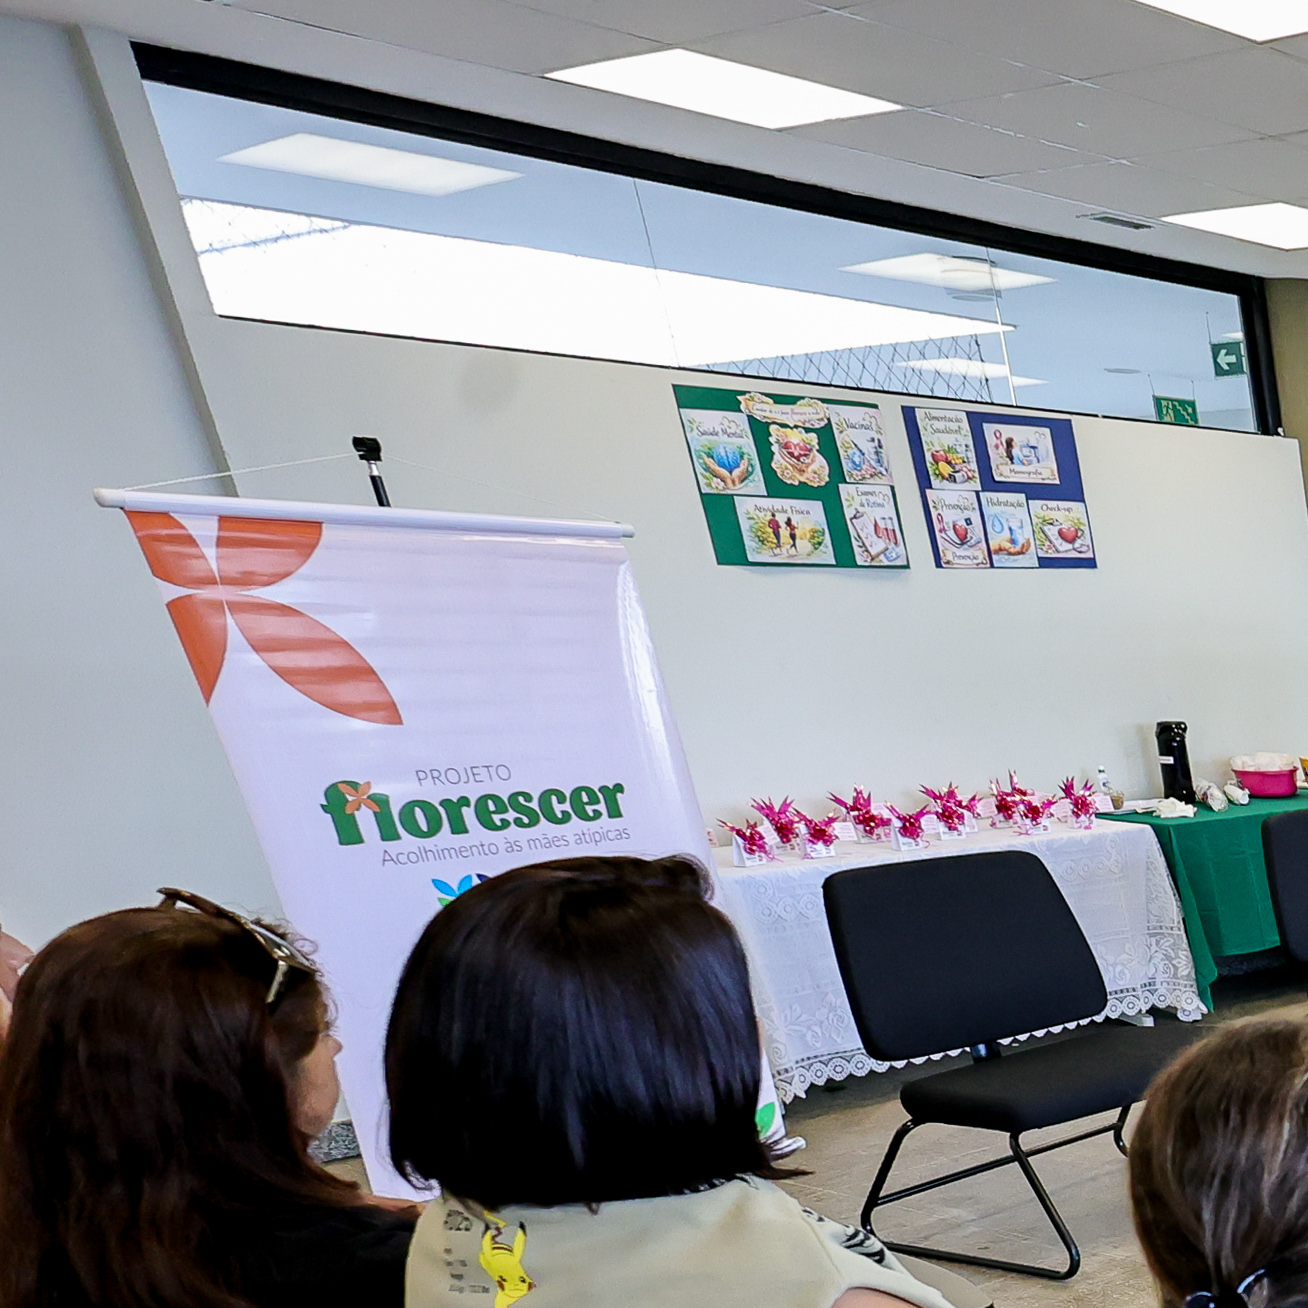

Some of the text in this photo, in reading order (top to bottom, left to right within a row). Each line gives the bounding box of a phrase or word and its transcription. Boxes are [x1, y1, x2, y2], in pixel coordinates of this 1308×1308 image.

[843, 417, 874, 431] Vacinas
[696, 426, 719, 438] Saúde
[754, 504, 789, 516] Atividade
[986, 497, 1025, 510] Hidratação
[1041, 503, 1073, 515] Check-up
[415, 763, 512, 787] PROJETO
[319, 779, 625, 846] florescer
[381, 826, 631, 867] Acolhimento às mães atípicas
